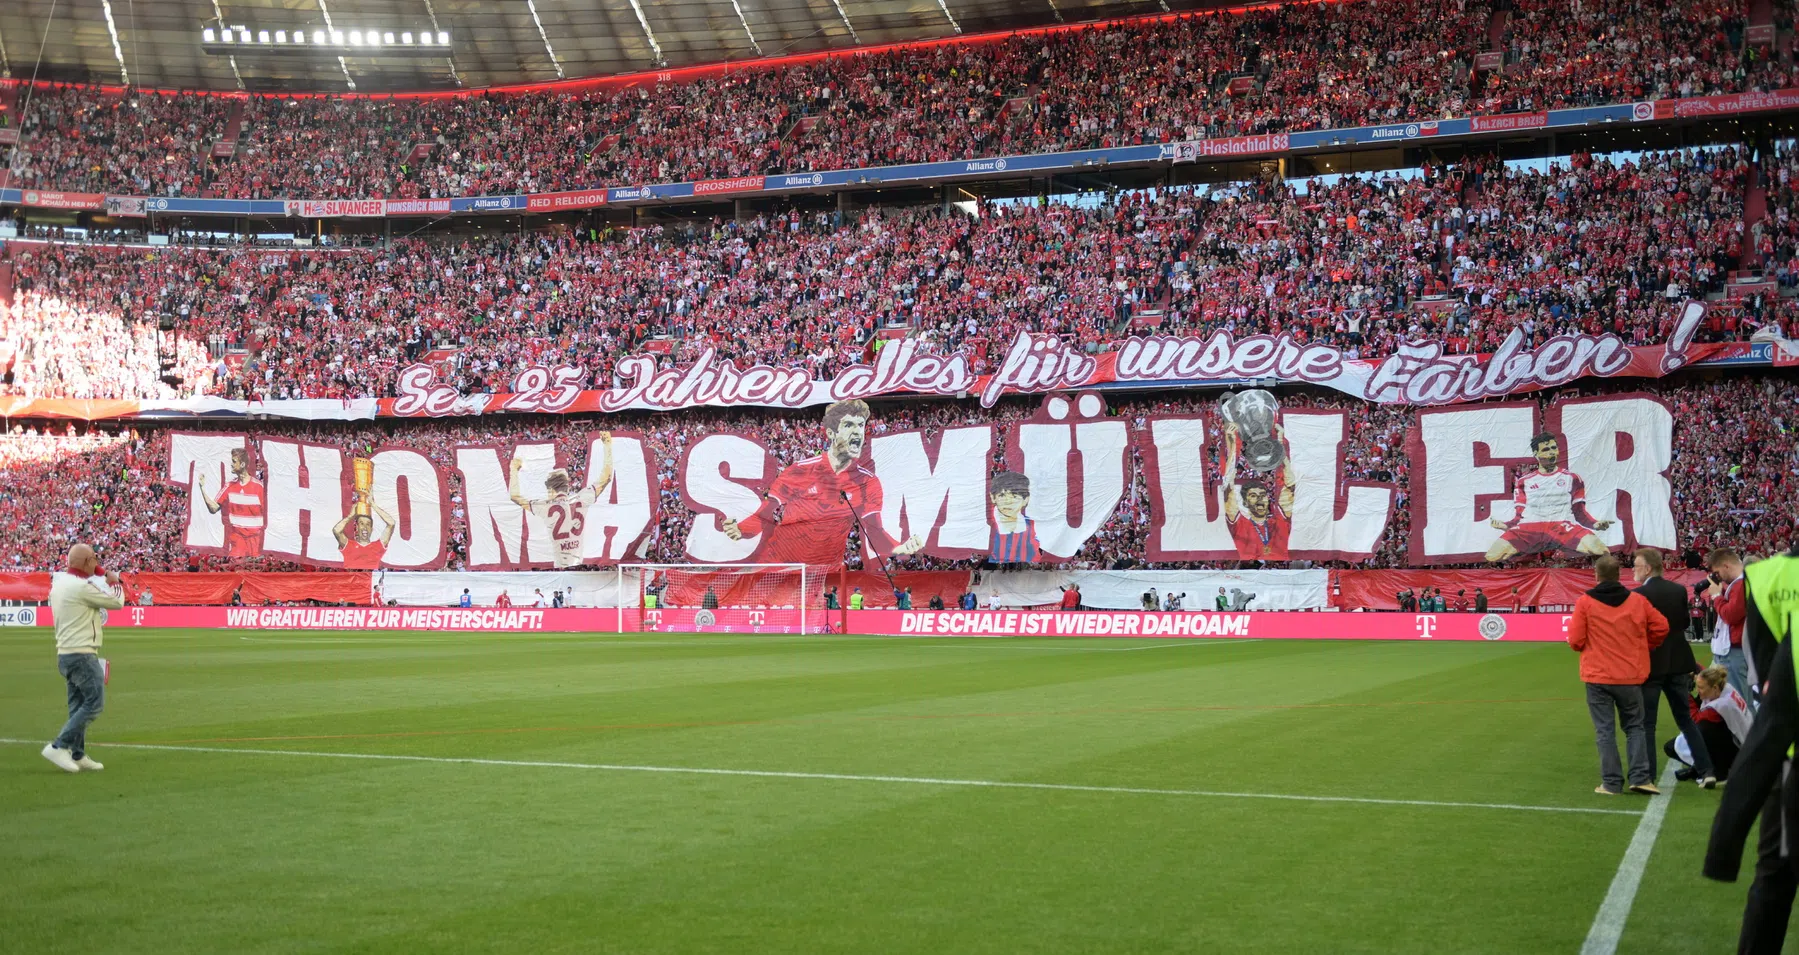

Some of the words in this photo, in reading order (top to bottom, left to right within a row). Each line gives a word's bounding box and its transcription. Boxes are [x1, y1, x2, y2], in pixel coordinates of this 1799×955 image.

[1472, 115, 1515, 130] SALZACH
[1517, 115, 1545, 127] BAZIS
[1372, 128, 1404, 138] Allianz
[1202, 134, 1271, 156] Haslachtal
[1272, 134, 1289, 151] 83
[966, 161, 994, 171] Allianz
[694, 177, 764, 192] GROSSHEIDE
[785, 177, 811, 185] Allianz
[530, 198, 551, 207] RED
[555, 194, 604, 206] RELIGION
[615, 190, 640, 199] Allianz
[474, 199, 499, 208] Allianz
[503, 363, 586, 412] 25
[600, 347, 814, 412] Jahren
[829, 337, 976, 400] alles
[981, 330, 1097, 409] für
[1115, 327, 1344, 382] unsere
[1364, 323, 1633, 406] Farben
[864, 392, 1678, 563] MÜLLER
[547, 501, 585, 540] 25
[227, 609, 258, 626] WIR
[260, 609, 365, 627] GRATULIEREN
[366, 609, 400, 627] ZUR
[402, 609, 543, 629] MEISTERSCHAFT!
[901, 612, 938, 632] DIE
[938, 612, 1016, 633] SCHALE
[1019, 613, 1053, 633] IST
[1053, 613, 1146, 634] WIEDER
[1149, 614, 1251, 635] DAHOAM!
